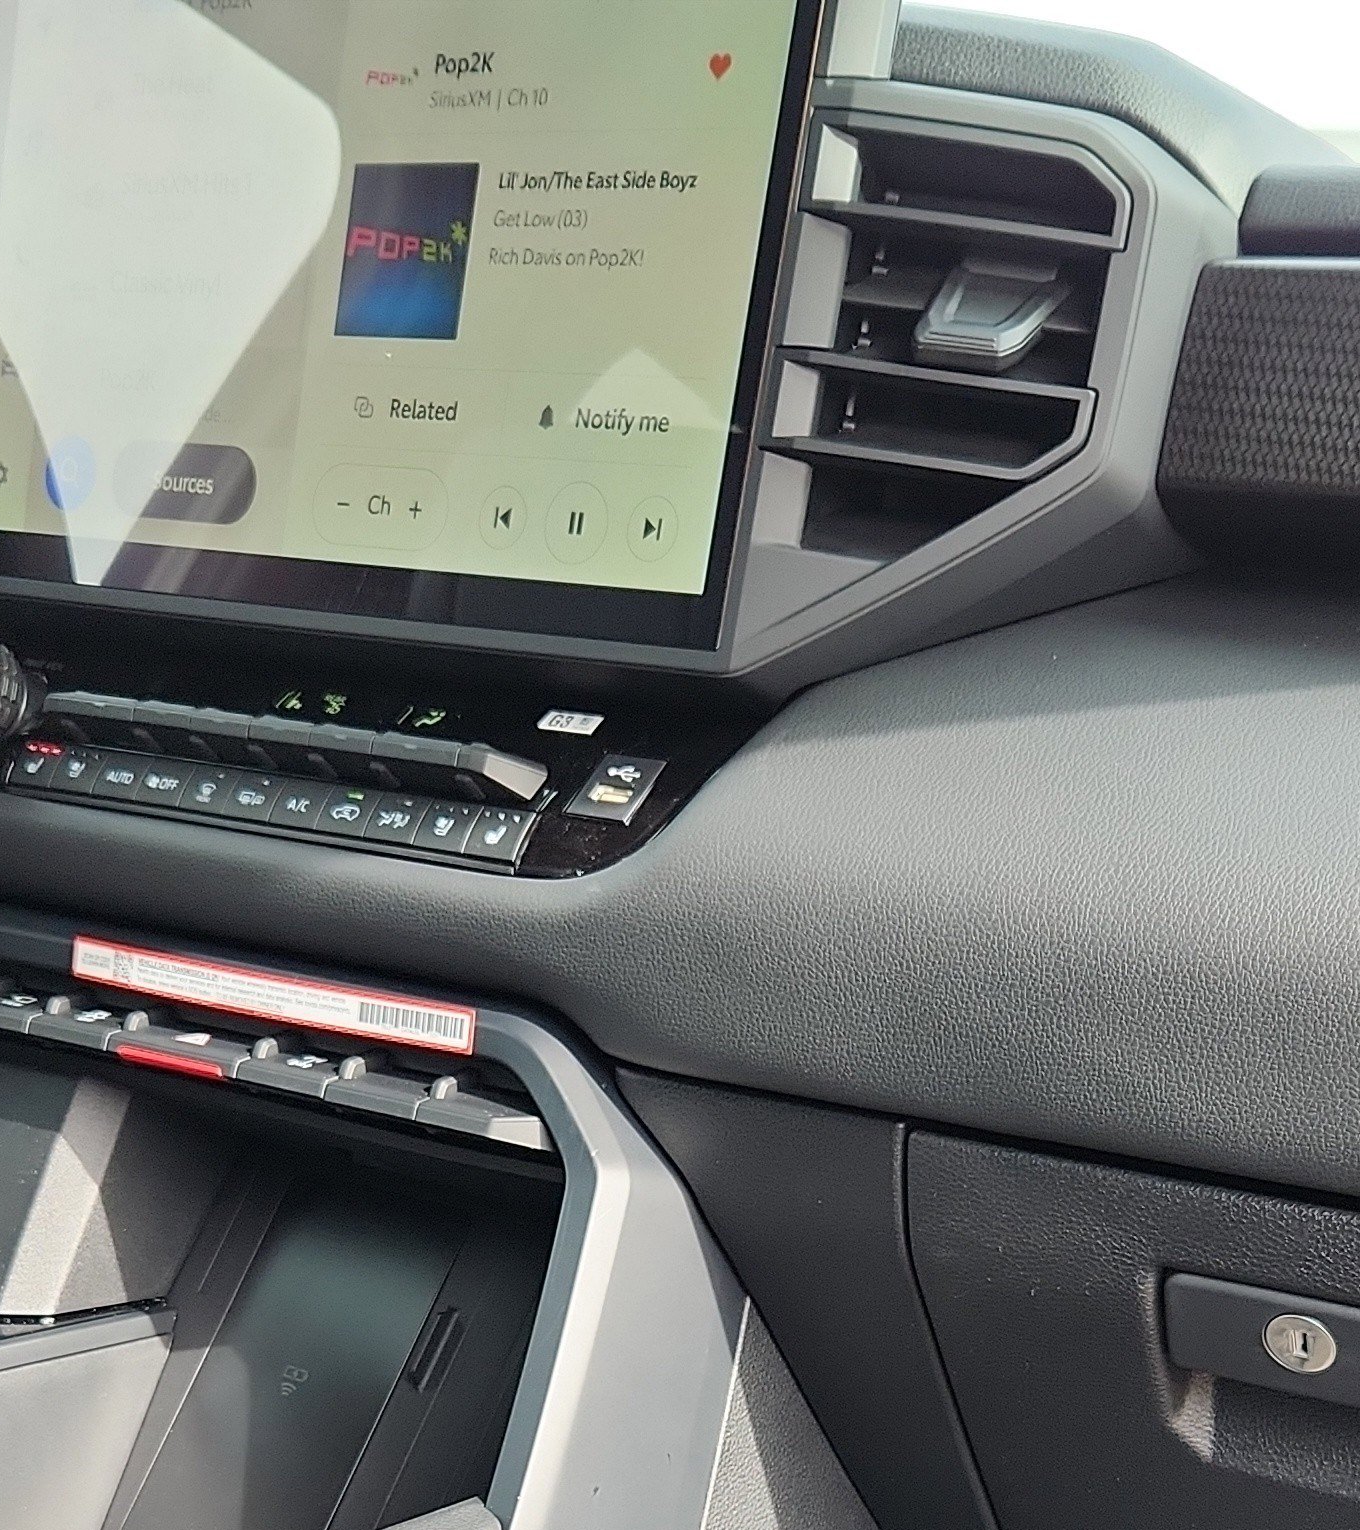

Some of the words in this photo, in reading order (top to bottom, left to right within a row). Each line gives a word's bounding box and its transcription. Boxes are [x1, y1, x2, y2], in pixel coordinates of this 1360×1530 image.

[434, 51, 495, 80] Pop2K
[429, 89, 491, 109] SiriusXM
[507, 88, 528, 106] Ch
[533, 87, 548, 106] 10
[520, 170, 583, 192] Jon/The
[586, 171, 619, 190] East
[621, 170, 656, 189] Side
[659, 170, 699, 193] Boyz
[493, 209, 520, 228] Get
[524, 210, 555, 228] Low
[557, 209, 588, 230] (03)
[489, 248, 519, 266] Rich
[522, 248, 561, 266] Davis
[565, 252, 585, 266] on
[589, 248, 645, 270] Pop2K!
[389, 398, 458, 422] Related
[575, 408, 634, 437] Notify
[638, 414, 670, 433] me
[367, 495, 391, 516] Ch
[548, 714, 575, 728] G3
[106, 771, 134, 785] AUTO
[158, 779, 180, 791] OFF
[286, 798, 310, 813] A/C
